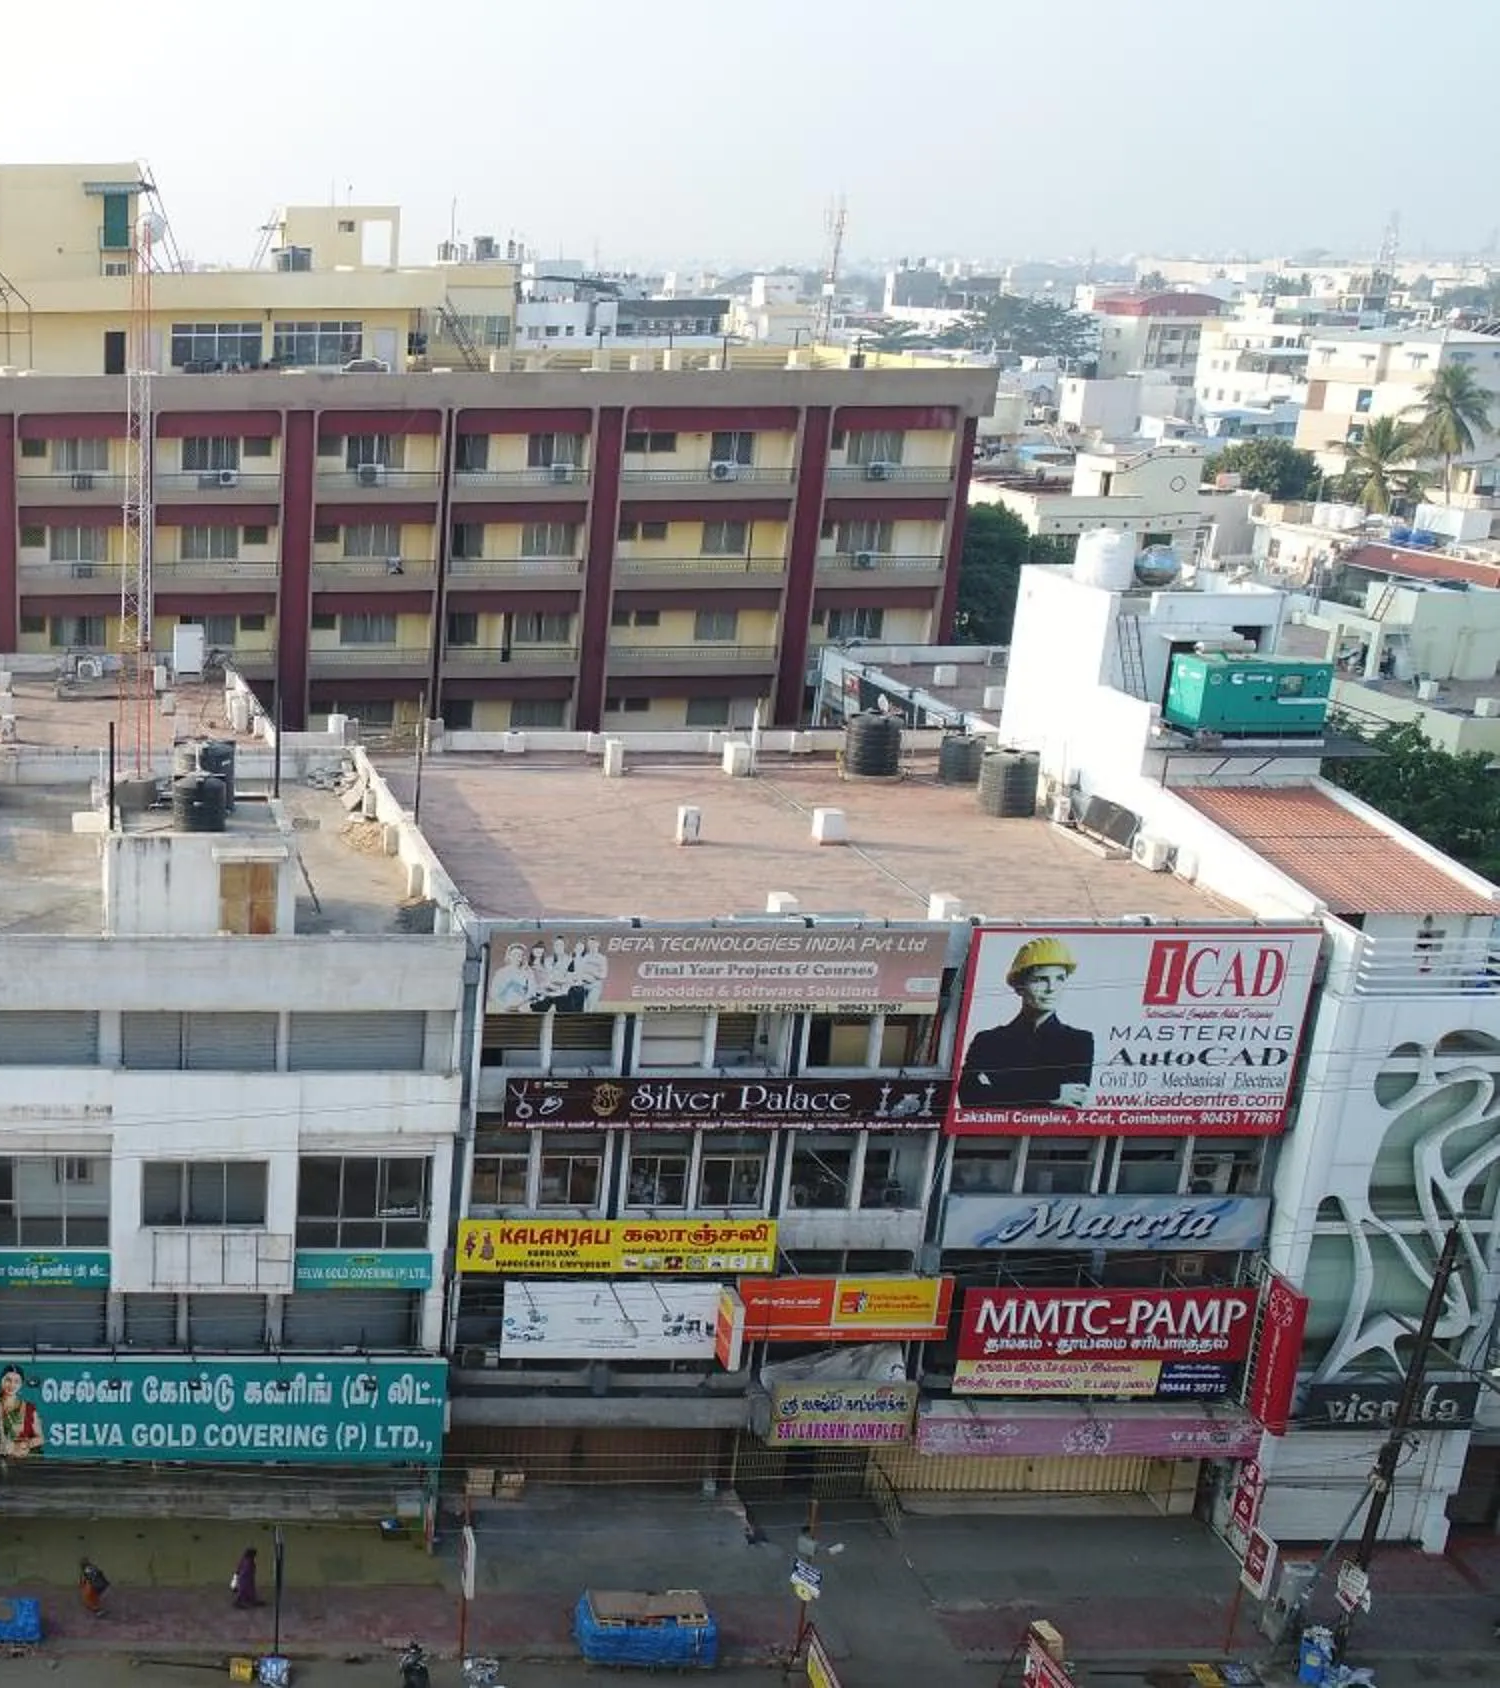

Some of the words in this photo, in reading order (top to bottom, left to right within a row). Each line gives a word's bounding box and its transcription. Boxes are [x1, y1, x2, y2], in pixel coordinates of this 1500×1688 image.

[608, 937, 655, 951] BETA
[659, 936, 803, 952] TECHNOLOGIES
[805, 937, 856, 951] INDIA
[860, 937, 894, 951] Pvt
[899, 937, 928, 951] Ltd
[645, 963, 684, 976] Final
[689, 964, 723, 976] Year
[727, 963, 791, 979] Projects
[813, 963, 874, 976] Courses
[1154, 946, 1285, 998] ICAD
[631, 984, 715, 998] Embedded
[733, 984, 801, 998] Software
[806, 984, 880, 998] Solutions
[1109, 1025, 1295, 1041] MASTERING
[1107, 1047, 1289, 1067] AutoCAD
[1100, 1071, 1129, 1088] Civil
[1131, 1072, 1147, 1088] 3D
[1162, 1072, 1227, 1088] Mechanical
[1233, 1072, 1287, 1088] Electrical
[631, 1083, 725, 1111] Silver
[738, 1083, 852, 1111] Palace
[1095, 1092, 1285, 1108] www.icadcentre.com
[954, 1111, 1009, 1123] Lakshmi
[1012, 1112, 1072, 1126] Complex,
[998, 1203, 1219, 1243] Marria
[499, 1228, 612, 1248] KALANJALI
[325, 1267, 349, 1279] GOLD
[975, 1299, 1248, 1335] MMTC-PAMP
[50, 1423, 125, 1447] SELVA
[131, 1423, 198, 1447] GOLD
[203, 1424, 329, 1447] COVERING
[335, 1421, 367, 1451] (P)
